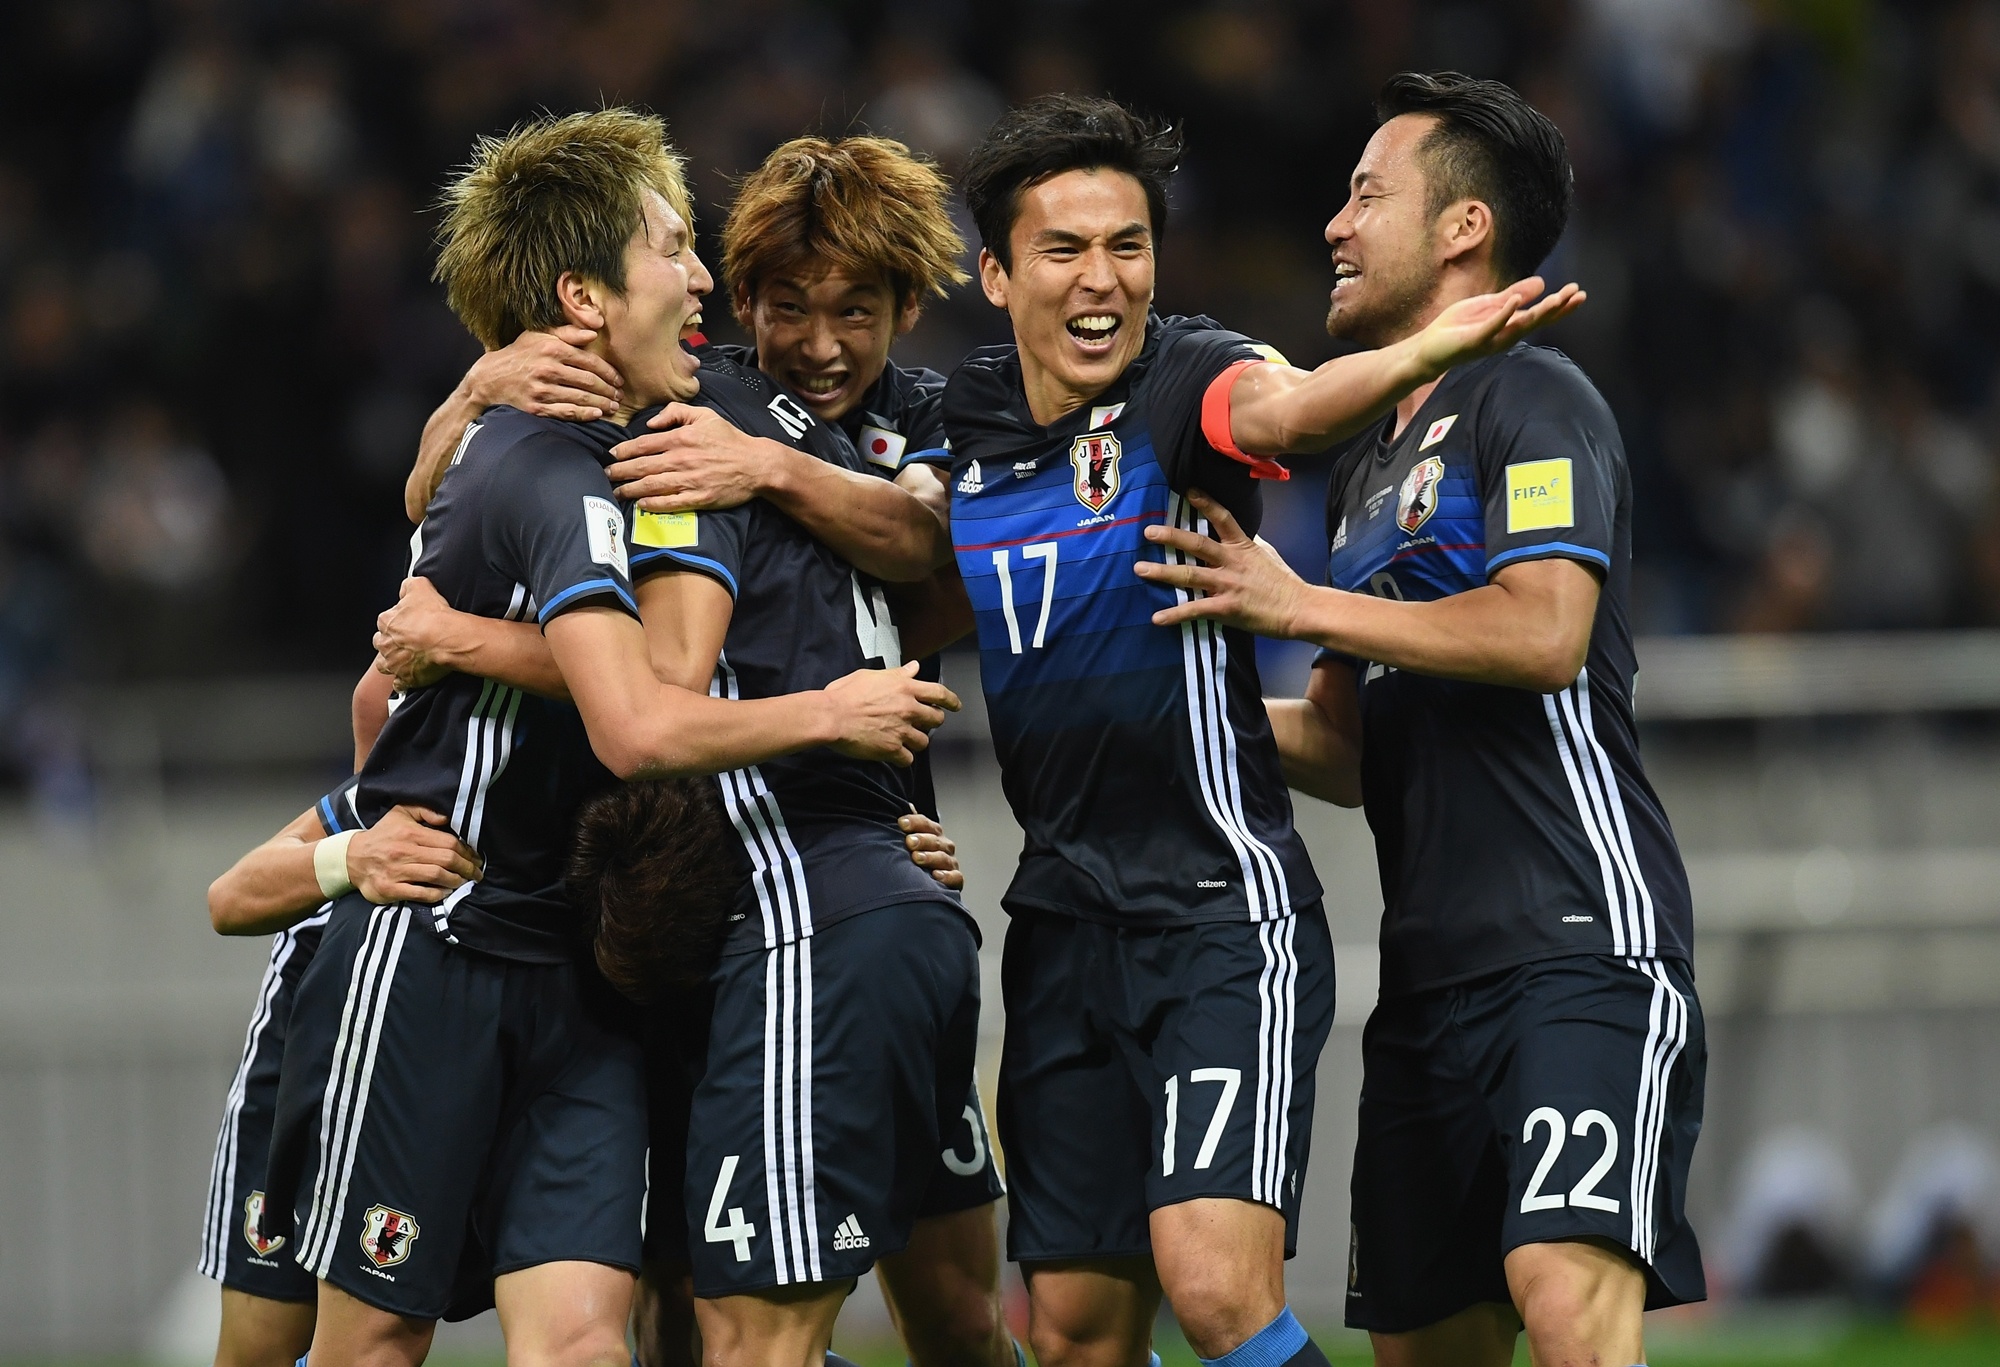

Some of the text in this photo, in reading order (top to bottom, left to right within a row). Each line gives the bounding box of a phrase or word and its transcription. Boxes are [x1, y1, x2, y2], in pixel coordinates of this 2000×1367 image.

[1080, 442, 1113, 458] JFA
[957, 480, 984, 493] adidas
[1513, 485, 1548, 500] FIFA
[1076, 513, 1116, 527] JAPAN
[1396, 536, 1436, 550] JAPAN
[992, 541, 1058, 654] 17
[850, 567, 902, 670] 4
[1196, 879, 1228, 888] adizero
[1561, 914, 1594, 923] adizero
[1162, 1067, 1242, 1178] 17
[1520, 1106, 1621, 1214] 22
[704, 1155, 756, 1262] 4
[374, 1212, 409, 1233] JFA
[833, 1233, 870, 1251] adidas
[246, 1256, 279, 1268] JAPAN
[359, 1264, 396, 1283] JAPAN
